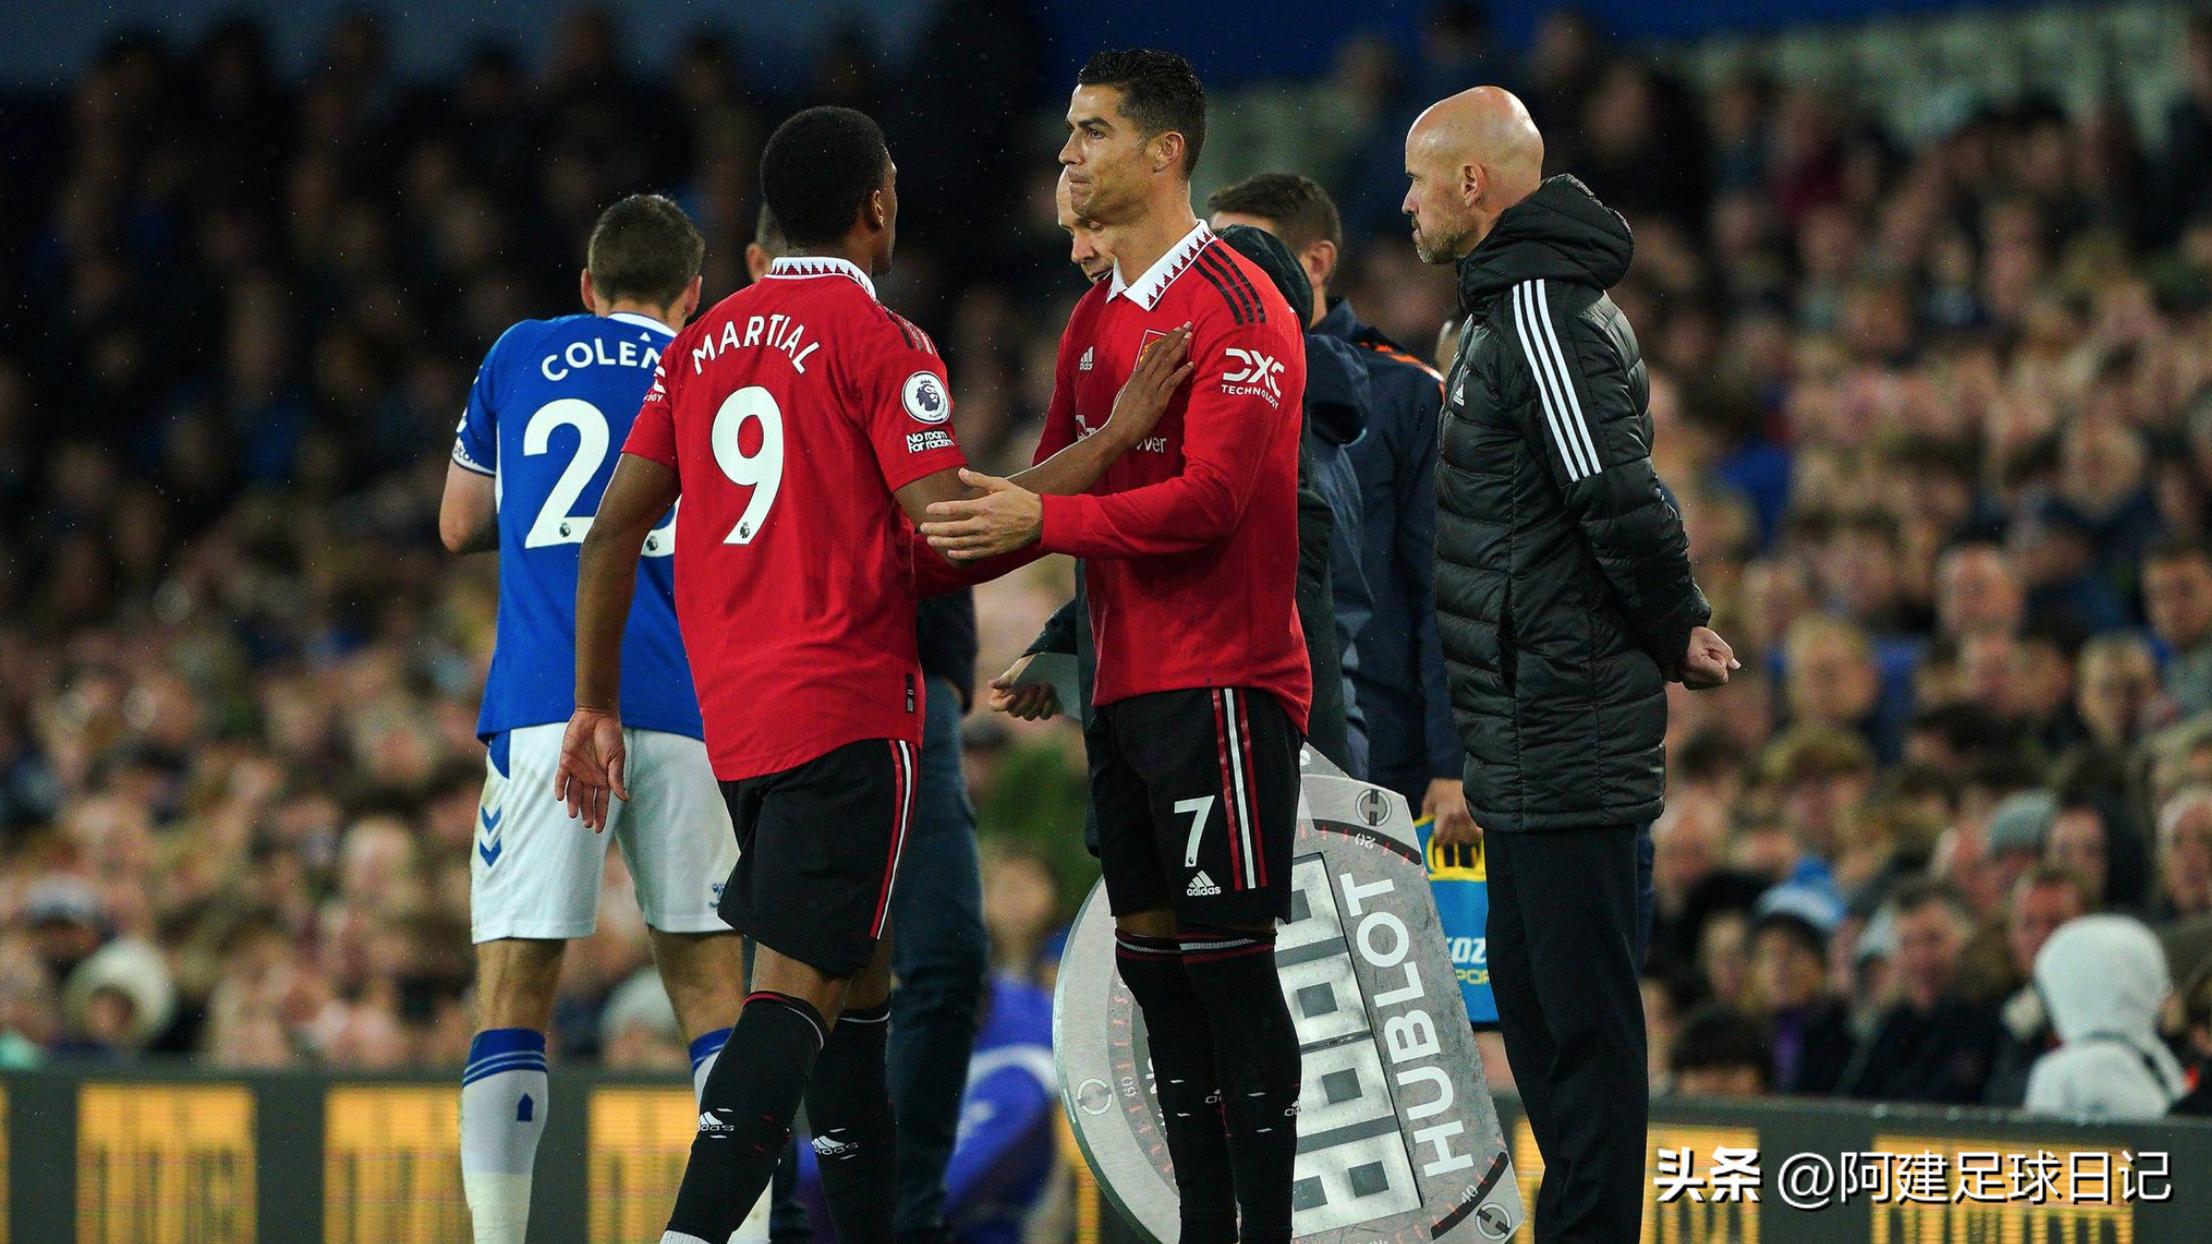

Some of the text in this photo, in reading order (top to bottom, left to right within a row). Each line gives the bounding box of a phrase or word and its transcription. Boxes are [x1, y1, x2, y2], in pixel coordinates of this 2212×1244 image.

[692, 313, 820, 375] MARTIAL
[1221, 384, 1279, 411] TECHNOLOGY
[906, 430, 948, 444] No room
[925, 438, 955, 450] racism
[712, 386, 784, 545] 9
[1174, 795, 1215, 868] 7
[1186, 885, 1222, 897] adidas
[1339, 872, 1474, 1178] HUBLOT
